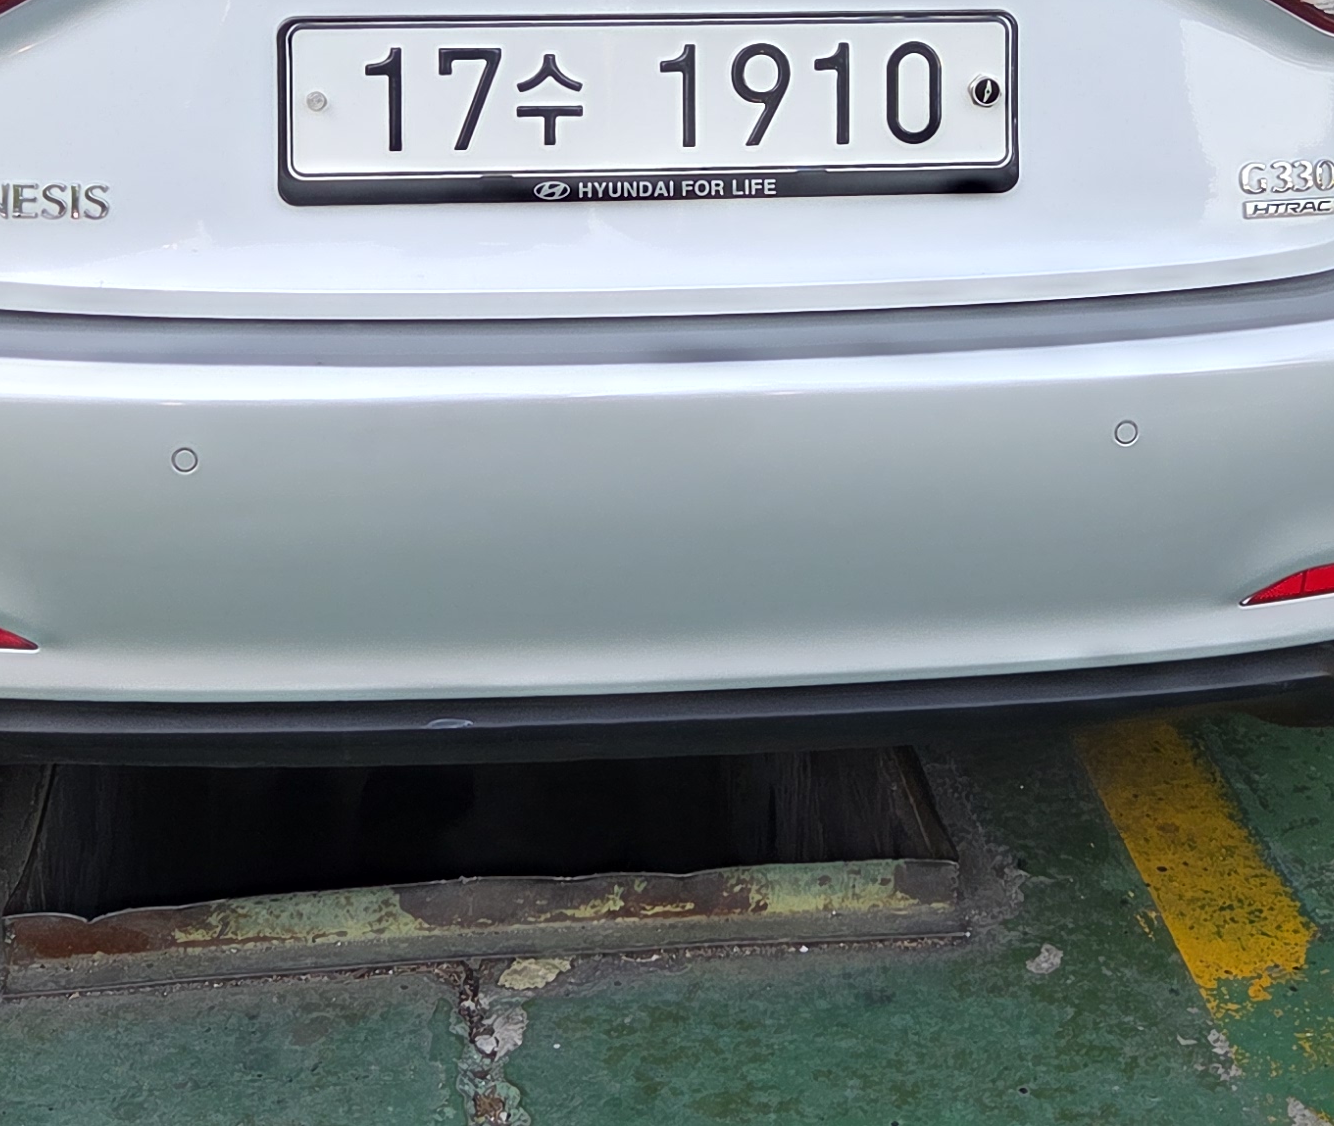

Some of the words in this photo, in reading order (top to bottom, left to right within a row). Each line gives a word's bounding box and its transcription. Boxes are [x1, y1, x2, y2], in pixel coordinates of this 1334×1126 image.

[364, 47, 584, 152] 17수
[659, 40, 943, 147] 1910
[578, 180, 675, 198] HYUNDAI
[681, 179, 725, 197] FOR
[732, 178, 777, 196] LIFE
[1251, 200, 1332, 216] HTRAC
